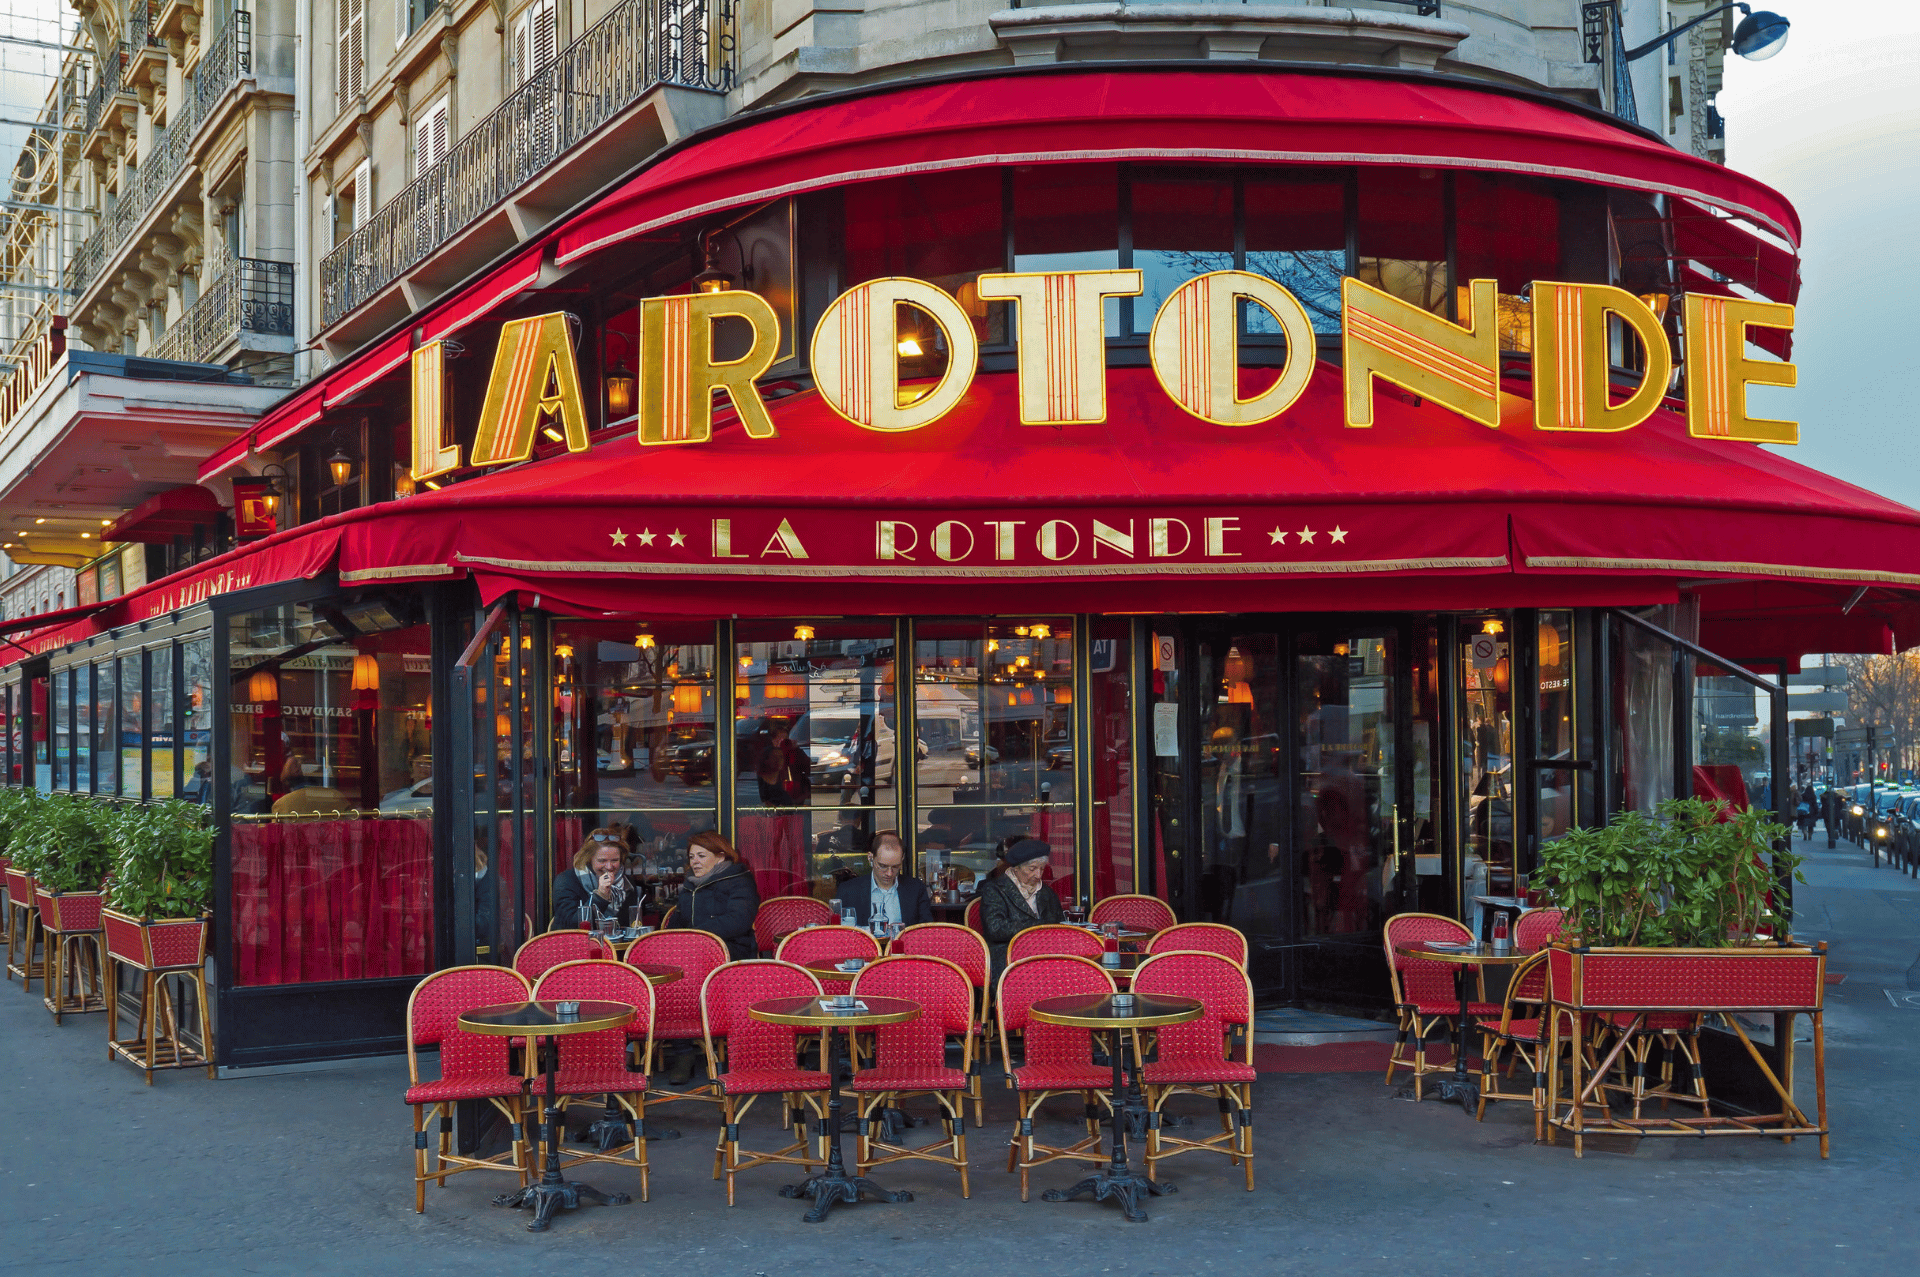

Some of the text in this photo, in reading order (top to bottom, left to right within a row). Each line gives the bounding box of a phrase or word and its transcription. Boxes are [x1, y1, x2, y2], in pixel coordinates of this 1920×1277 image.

[411, 269, 1801, 482] LA ROTONDE
[711, 517, 1242, 562] LA ROTONDE
